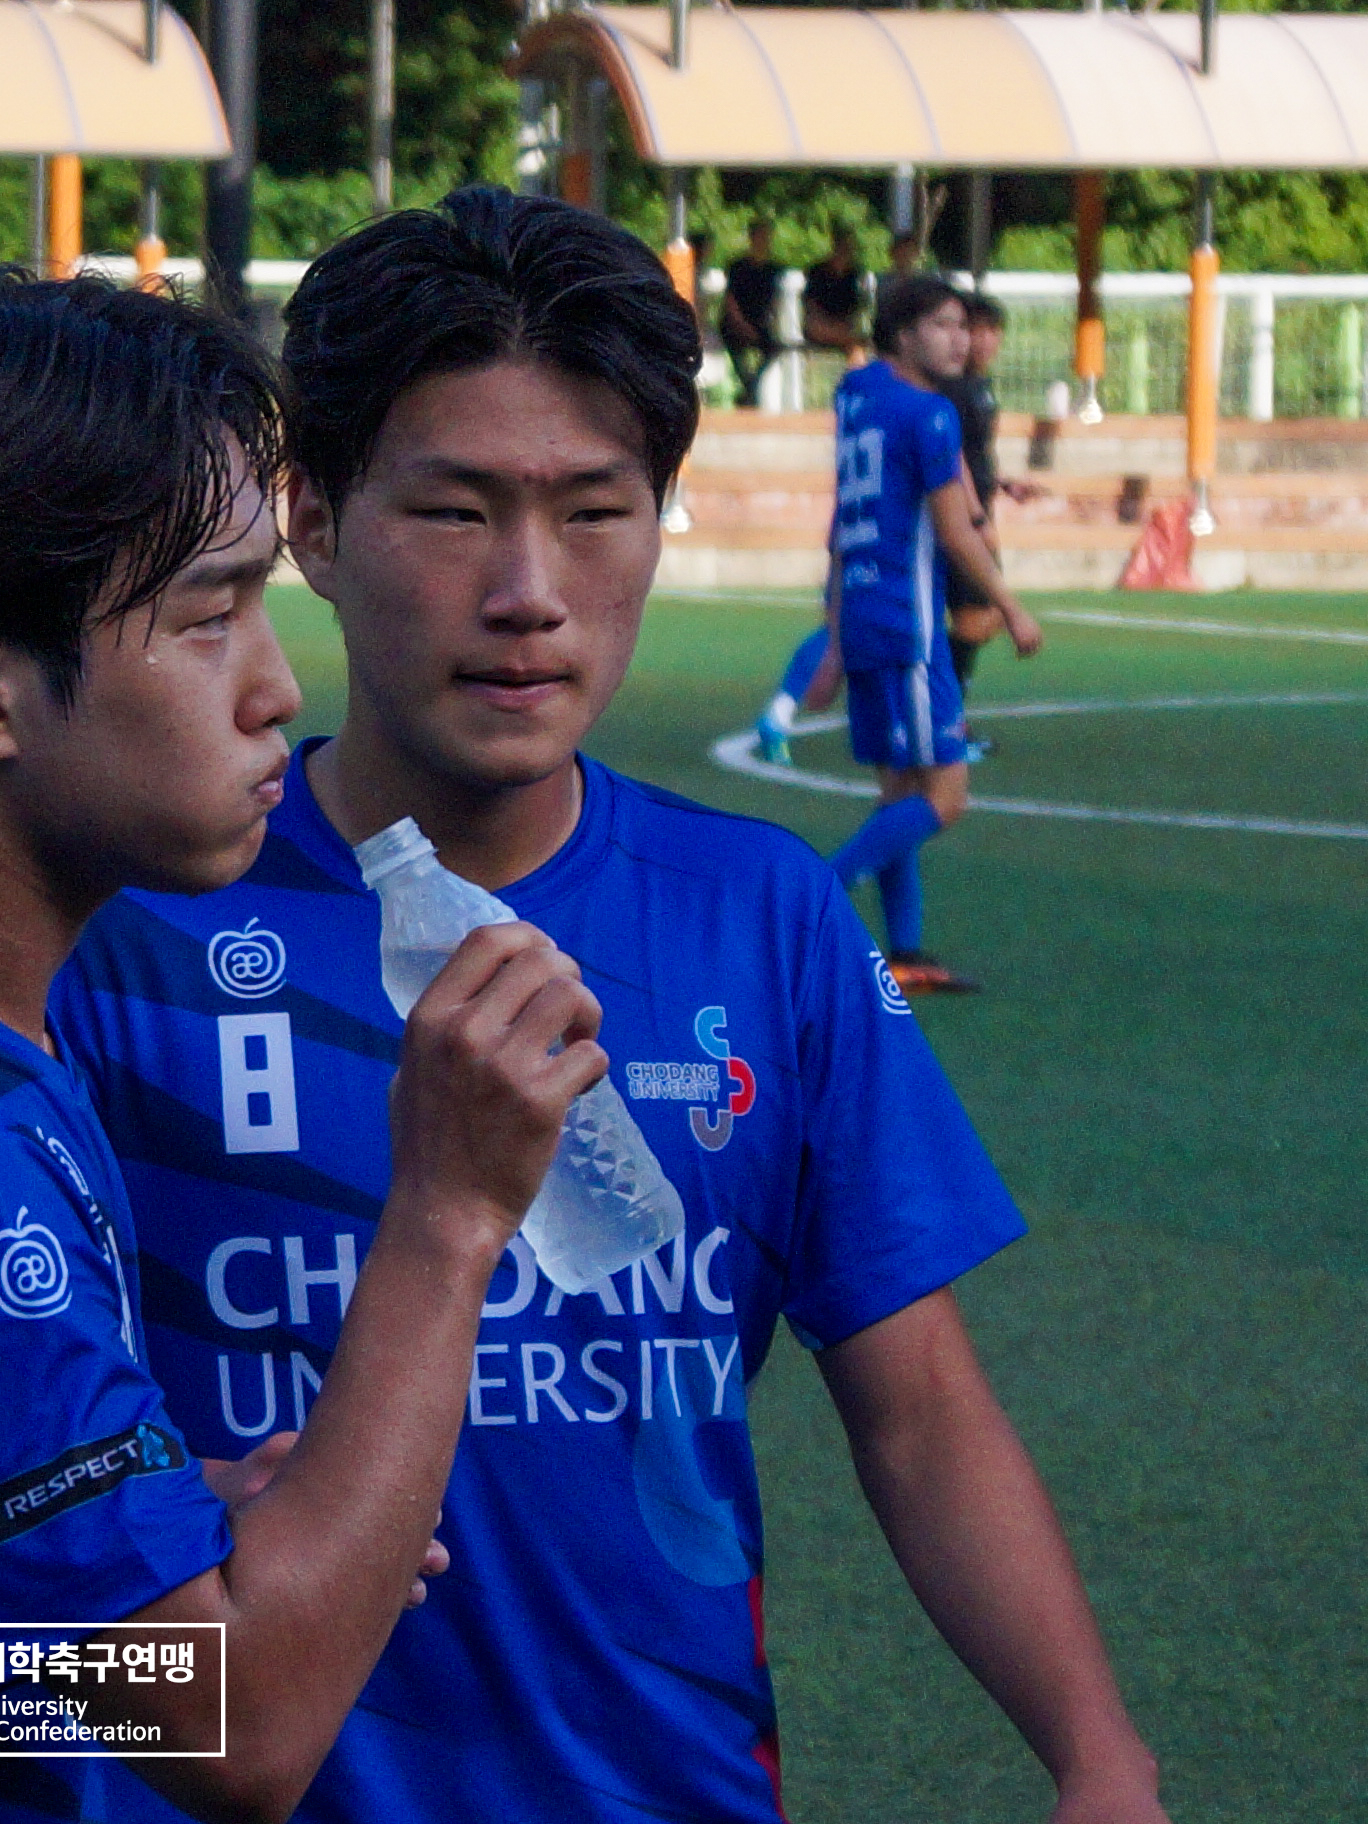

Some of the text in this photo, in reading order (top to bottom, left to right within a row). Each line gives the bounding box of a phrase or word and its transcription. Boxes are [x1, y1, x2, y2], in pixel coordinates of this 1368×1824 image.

[218, 1013, 299, 1154] 8
[626, 1062, 720, 1082] CHODANG
[628, 1080, 720, 1102] UNIVERSITY
[206, 1232, 734, 1330] CHDNG
[217, 1336, 740, 1437] UERSITY
[4, 1439, 138, 1520] RESPECT
